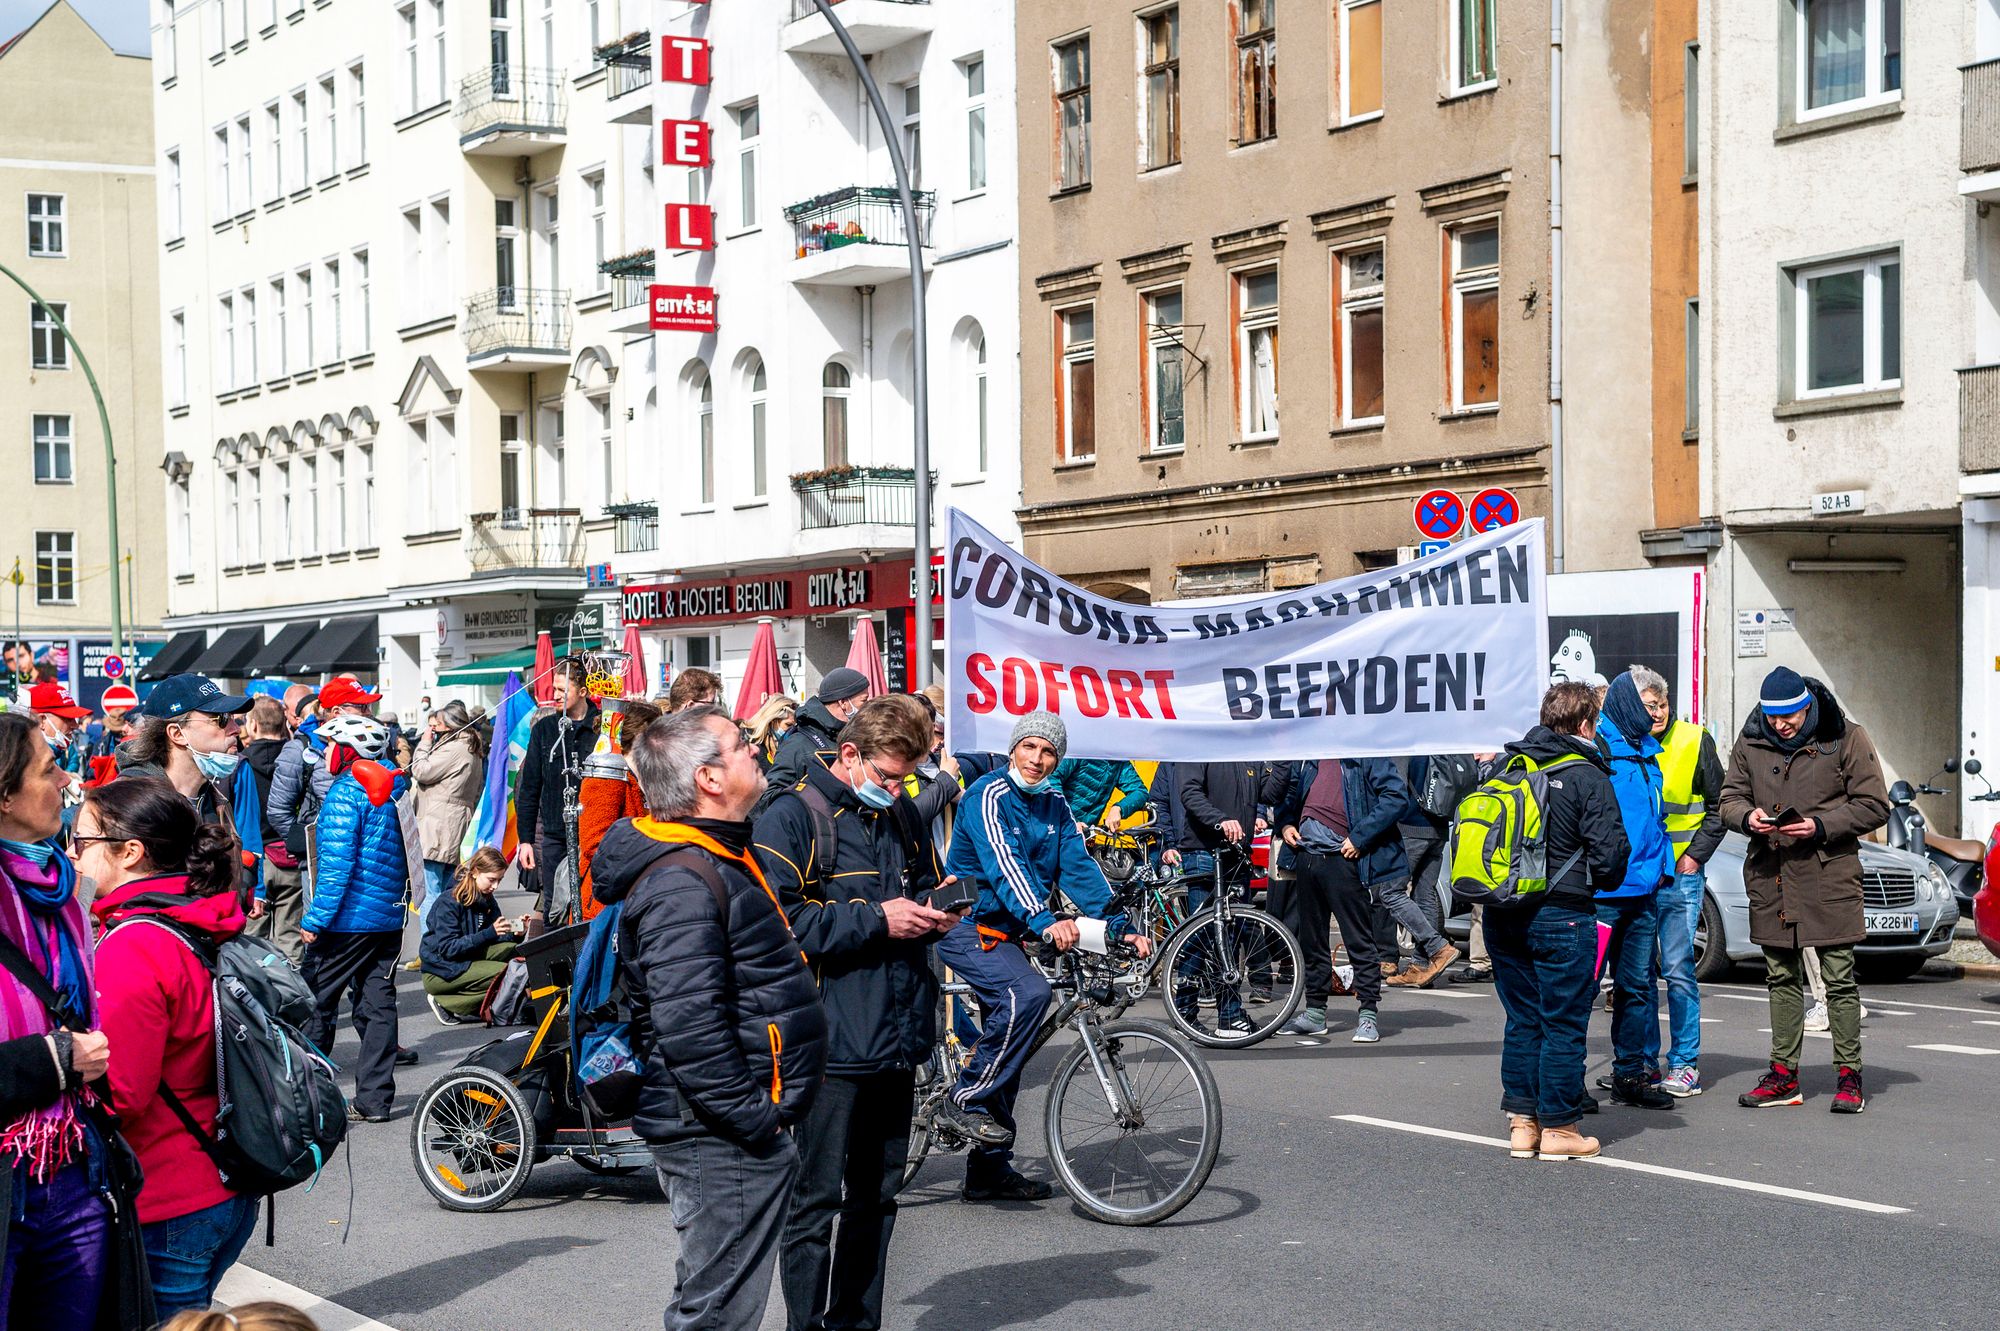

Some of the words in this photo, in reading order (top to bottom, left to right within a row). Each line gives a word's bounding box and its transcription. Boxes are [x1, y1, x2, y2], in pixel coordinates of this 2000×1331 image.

[656, 298, 683, 313] CITY
[697, 300, 713, 315] 54
[1822, 496, 1833, 510] 52
[1835, 495, 1851, 508] A-B
[622, 591, 663, 620] HOTEL
[665, 590, 675, 617] &
[679, 586, 730, 616] HOSTEL
[736, 581, 785, 613] BERLIN
[808, 574, 834, 607] CITY
[849, 570, 865, 604] 54
[481, 609, 528, 626] GRUNDBESITZ
[965, 652, 1178, 720] SOFORT
[1222, 652, 1487, 721] BEENDEN!
